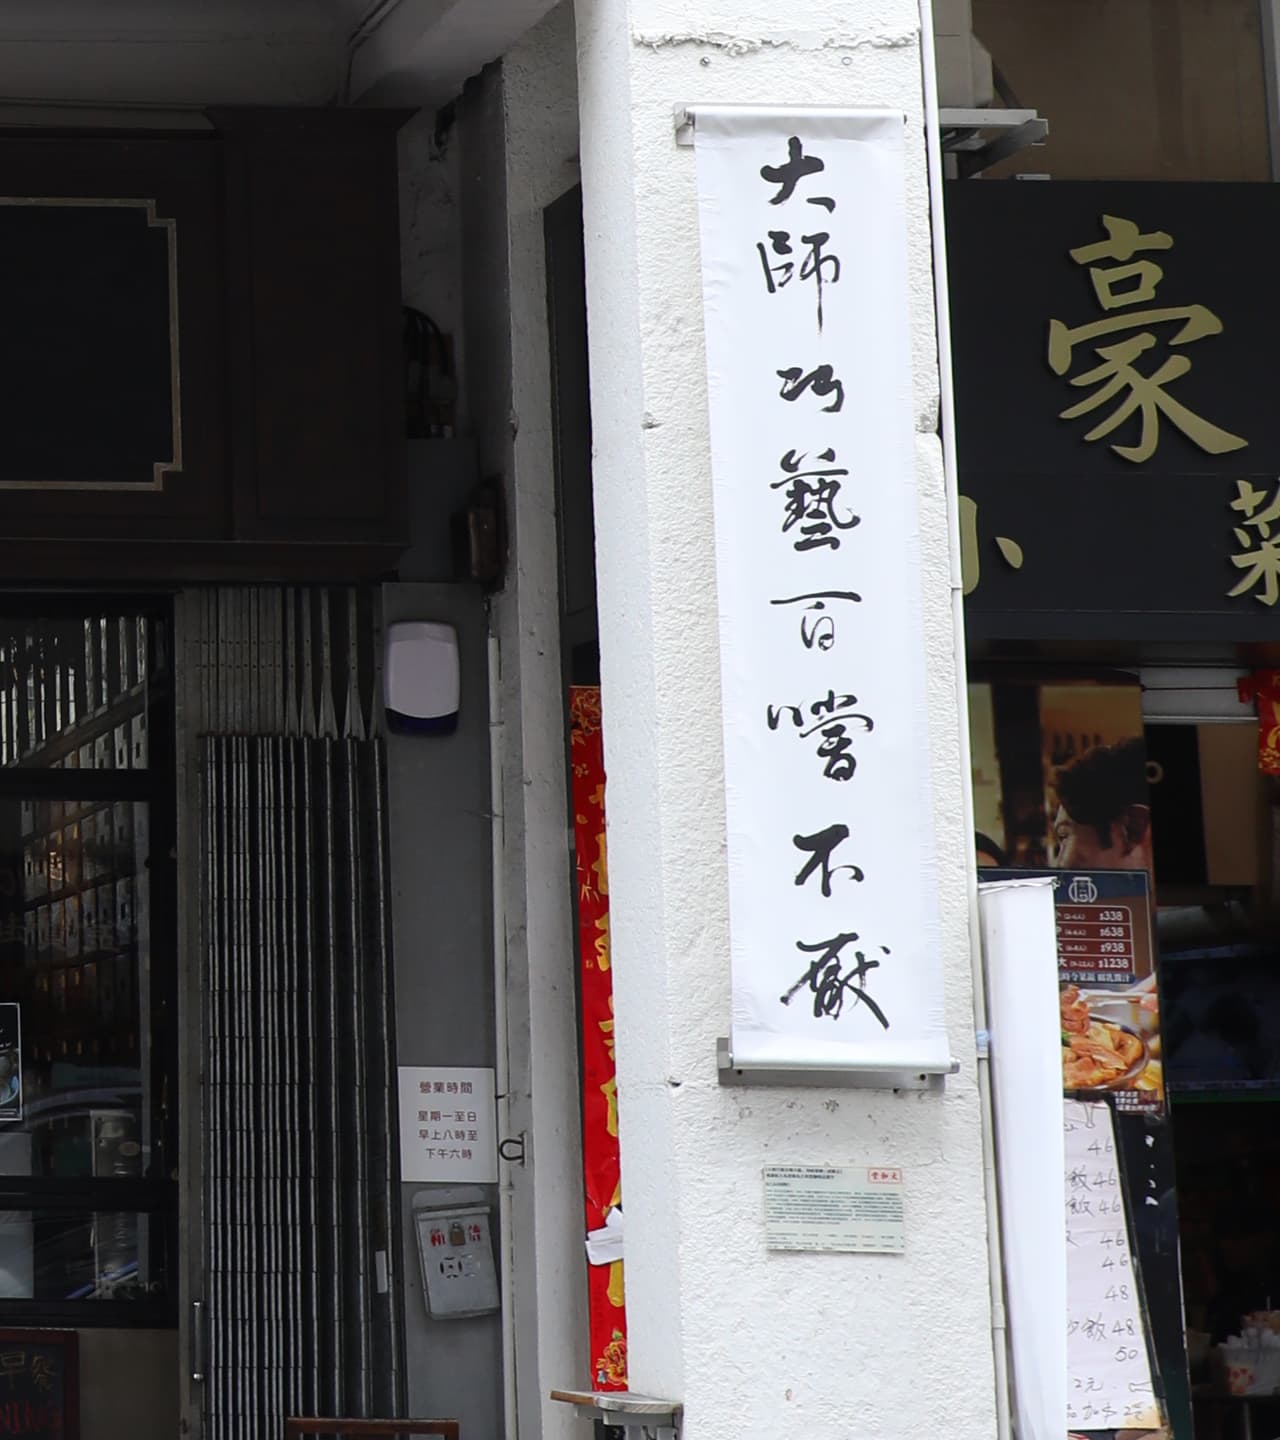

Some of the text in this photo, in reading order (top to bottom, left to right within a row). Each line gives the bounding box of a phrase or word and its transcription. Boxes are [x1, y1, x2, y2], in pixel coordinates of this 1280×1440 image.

[1047, 212, 1249, 464] 豪
[419, 1081, 473, 1094] 營業時間
[418, 1110, 478, 1122] 星期一至日
[418, 1129, 478, 1141] 早上八時至
[425, 1148, 473, 1160] 下午六時
[1093, 1168, 1116, 1188] 46
[1099, 1195, 1121, 1215] 46
[1104, 1284, 1130, 1302] 48
[1111, 1318, 1135, 1337] 48
[1115, 1346, 1138, 1362] 50
